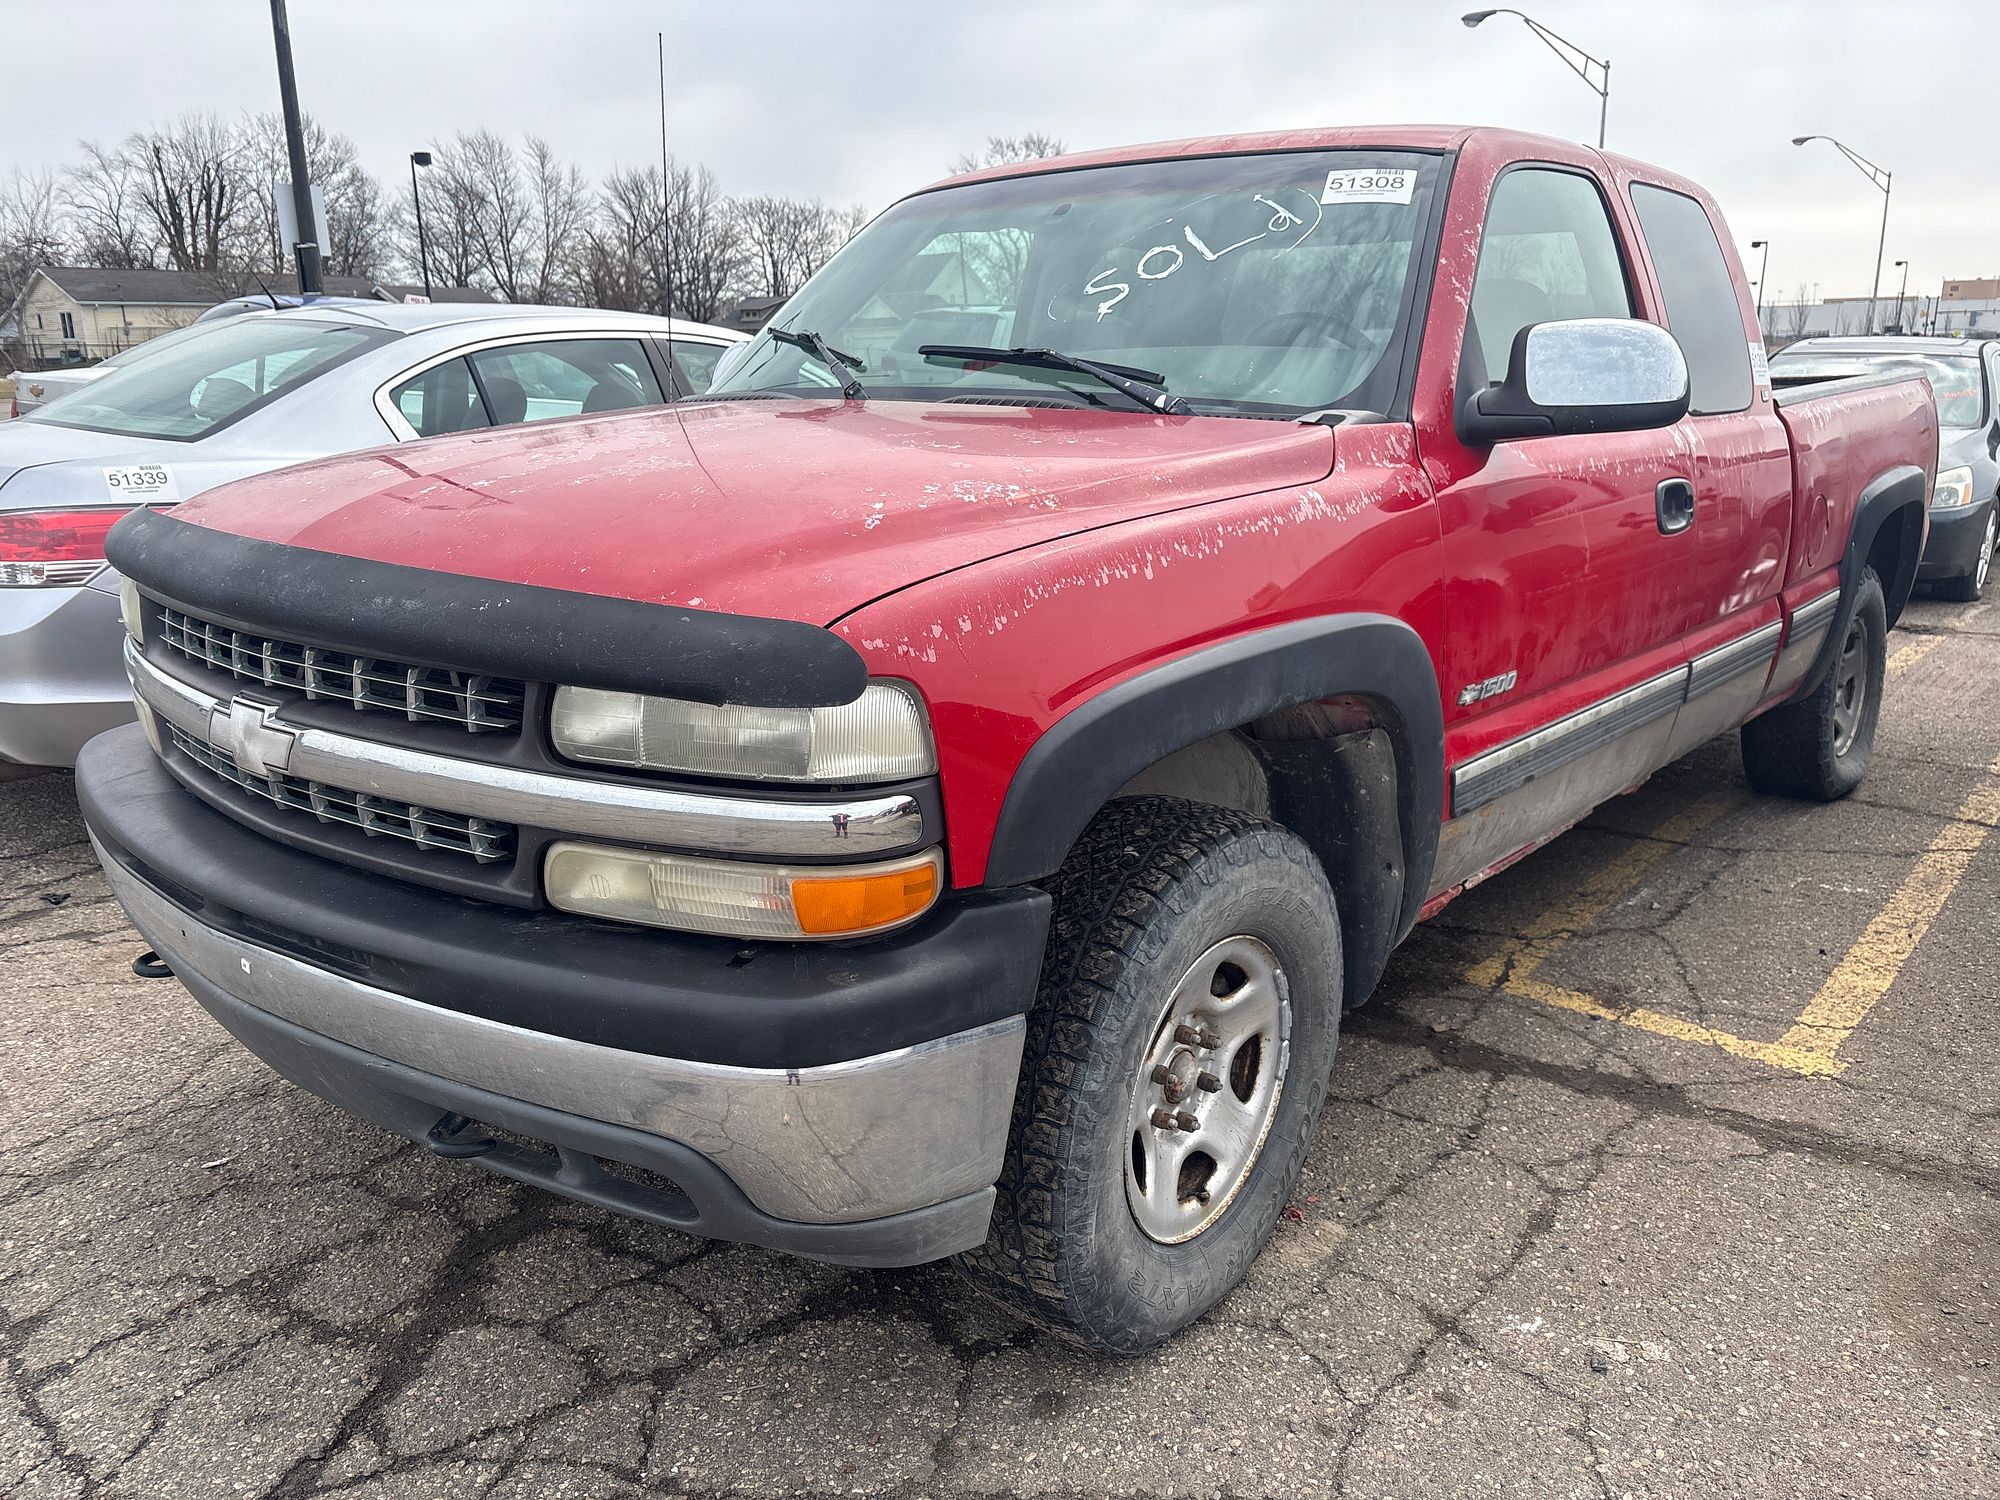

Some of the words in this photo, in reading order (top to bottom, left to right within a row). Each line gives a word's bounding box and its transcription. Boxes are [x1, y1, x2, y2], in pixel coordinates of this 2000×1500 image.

[1329, 176, 1405, 190] 51308
[109, 471, 168, 487] 51339
[1480, 670, 1518, 700] 1500
[1127, 1269, 1208, 1311] AXT2
